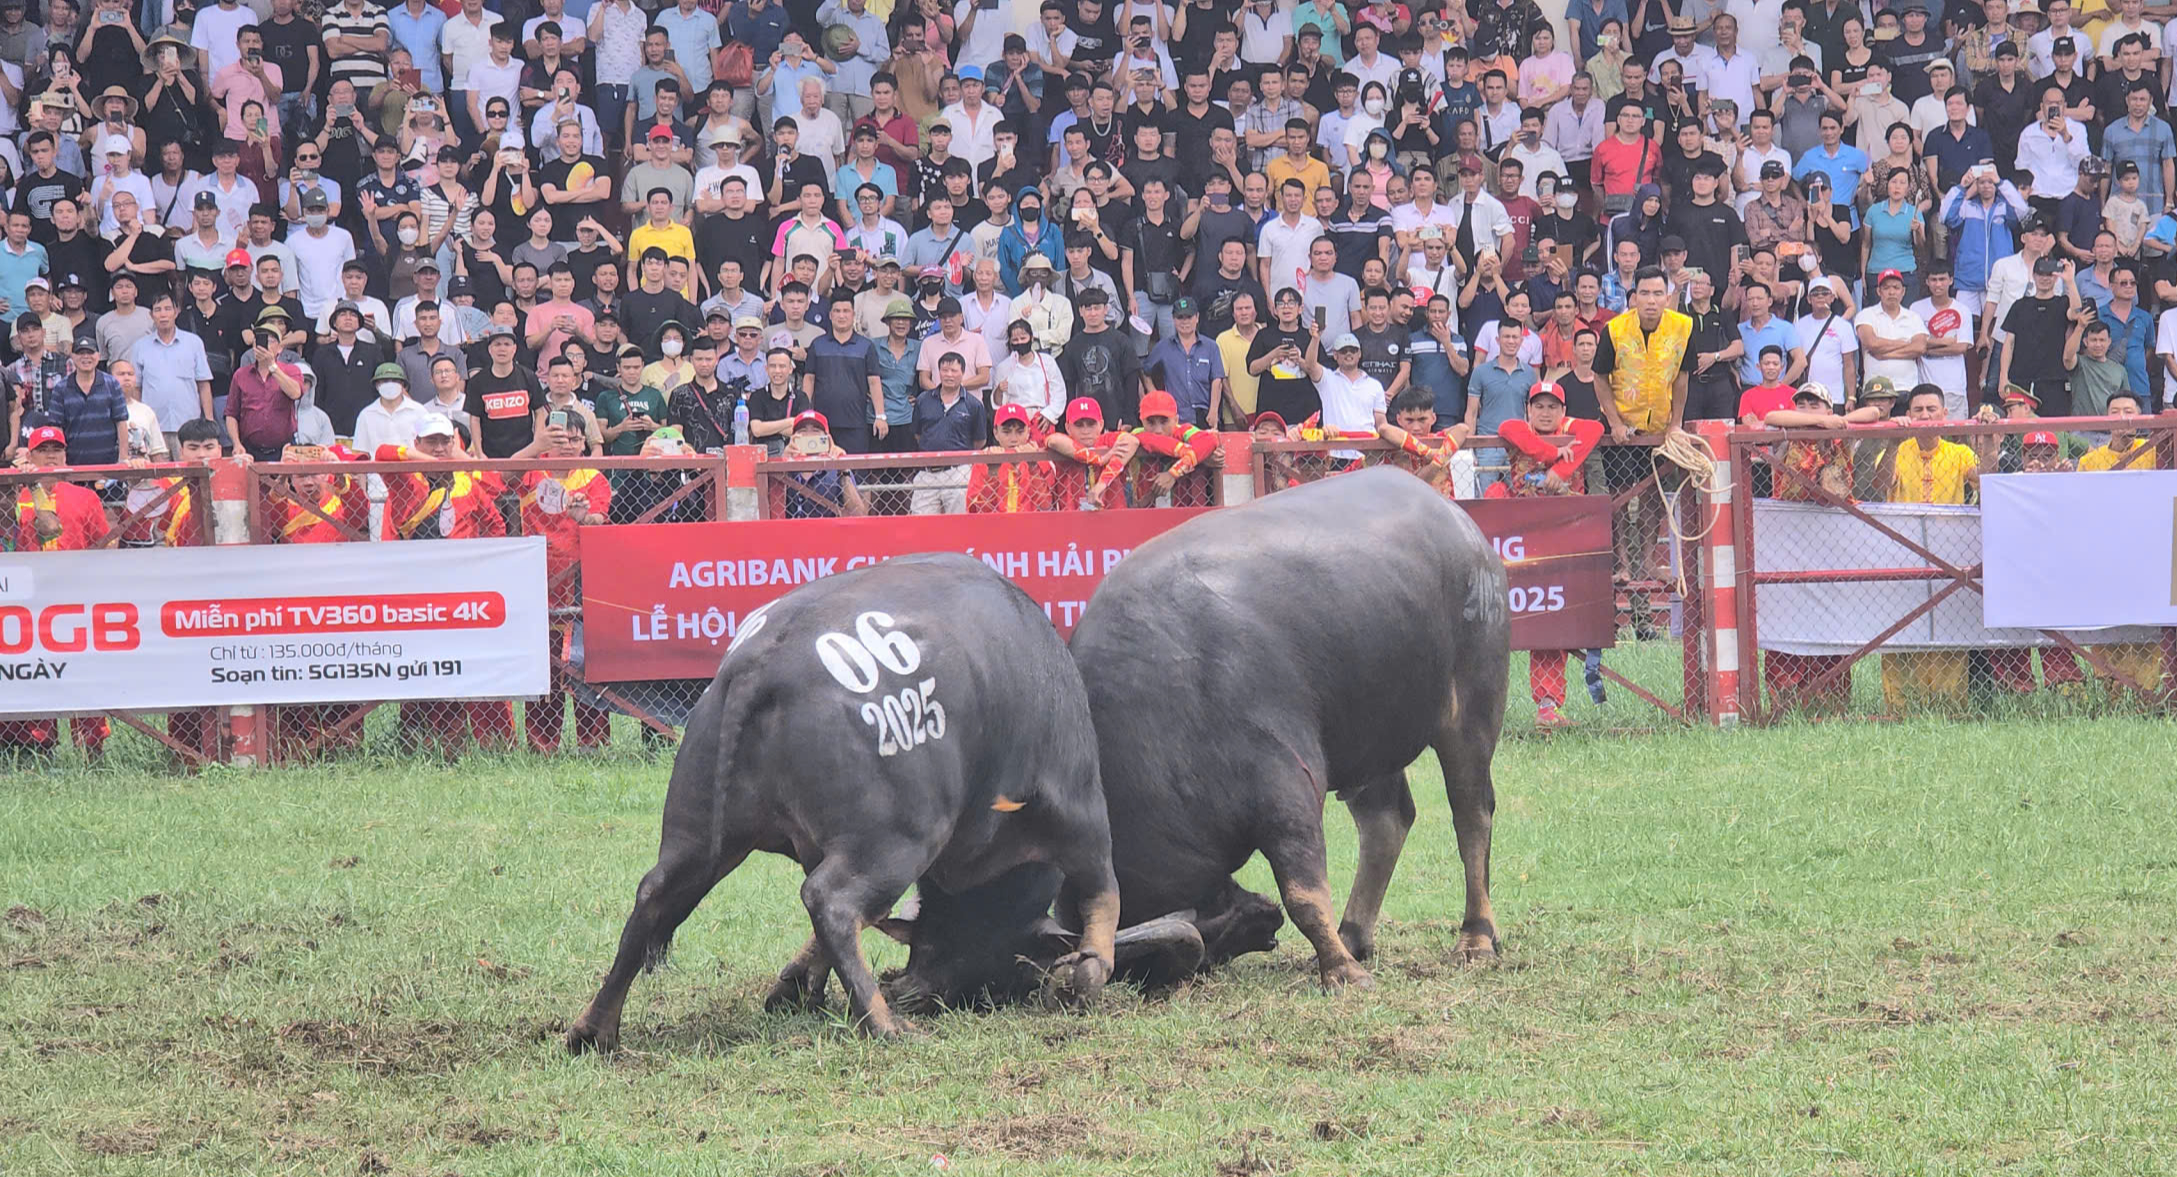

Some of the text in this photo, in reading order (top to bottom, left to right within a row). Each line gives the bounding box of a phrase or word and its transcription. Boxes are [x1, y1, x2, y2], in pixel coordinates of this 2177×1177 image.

[486, 396, 526, 411] KENZO
[620, 400, 649, 411] AIDAS
[669, 557, 839, 588] AGRIBANK
[1037, 542, 1094, 577] HẢI
[175, 601, 491, 632] Miễn phí TV360 basic 4K
[632, 603, 669, 641] LỄ
[677, 606, 736, 646] HỘI
[1508, 586, 1566, 613] 025
[210, 645, 236, 661] Chỉ
[240, 645, 258, 660] từ
[269, 641, 403, 660] 135.000đ/tháng
[815, 611, 921, 694] 06
[0, 657, 67, 681] NGÀY
[211, 667, 266, 685] Soạn
[271, 666, 303, 682] tin:
[397, 659, 428, 681] gửi
[432, 660, 462, 676] 191
[861, 677, 946, 757] 2025
